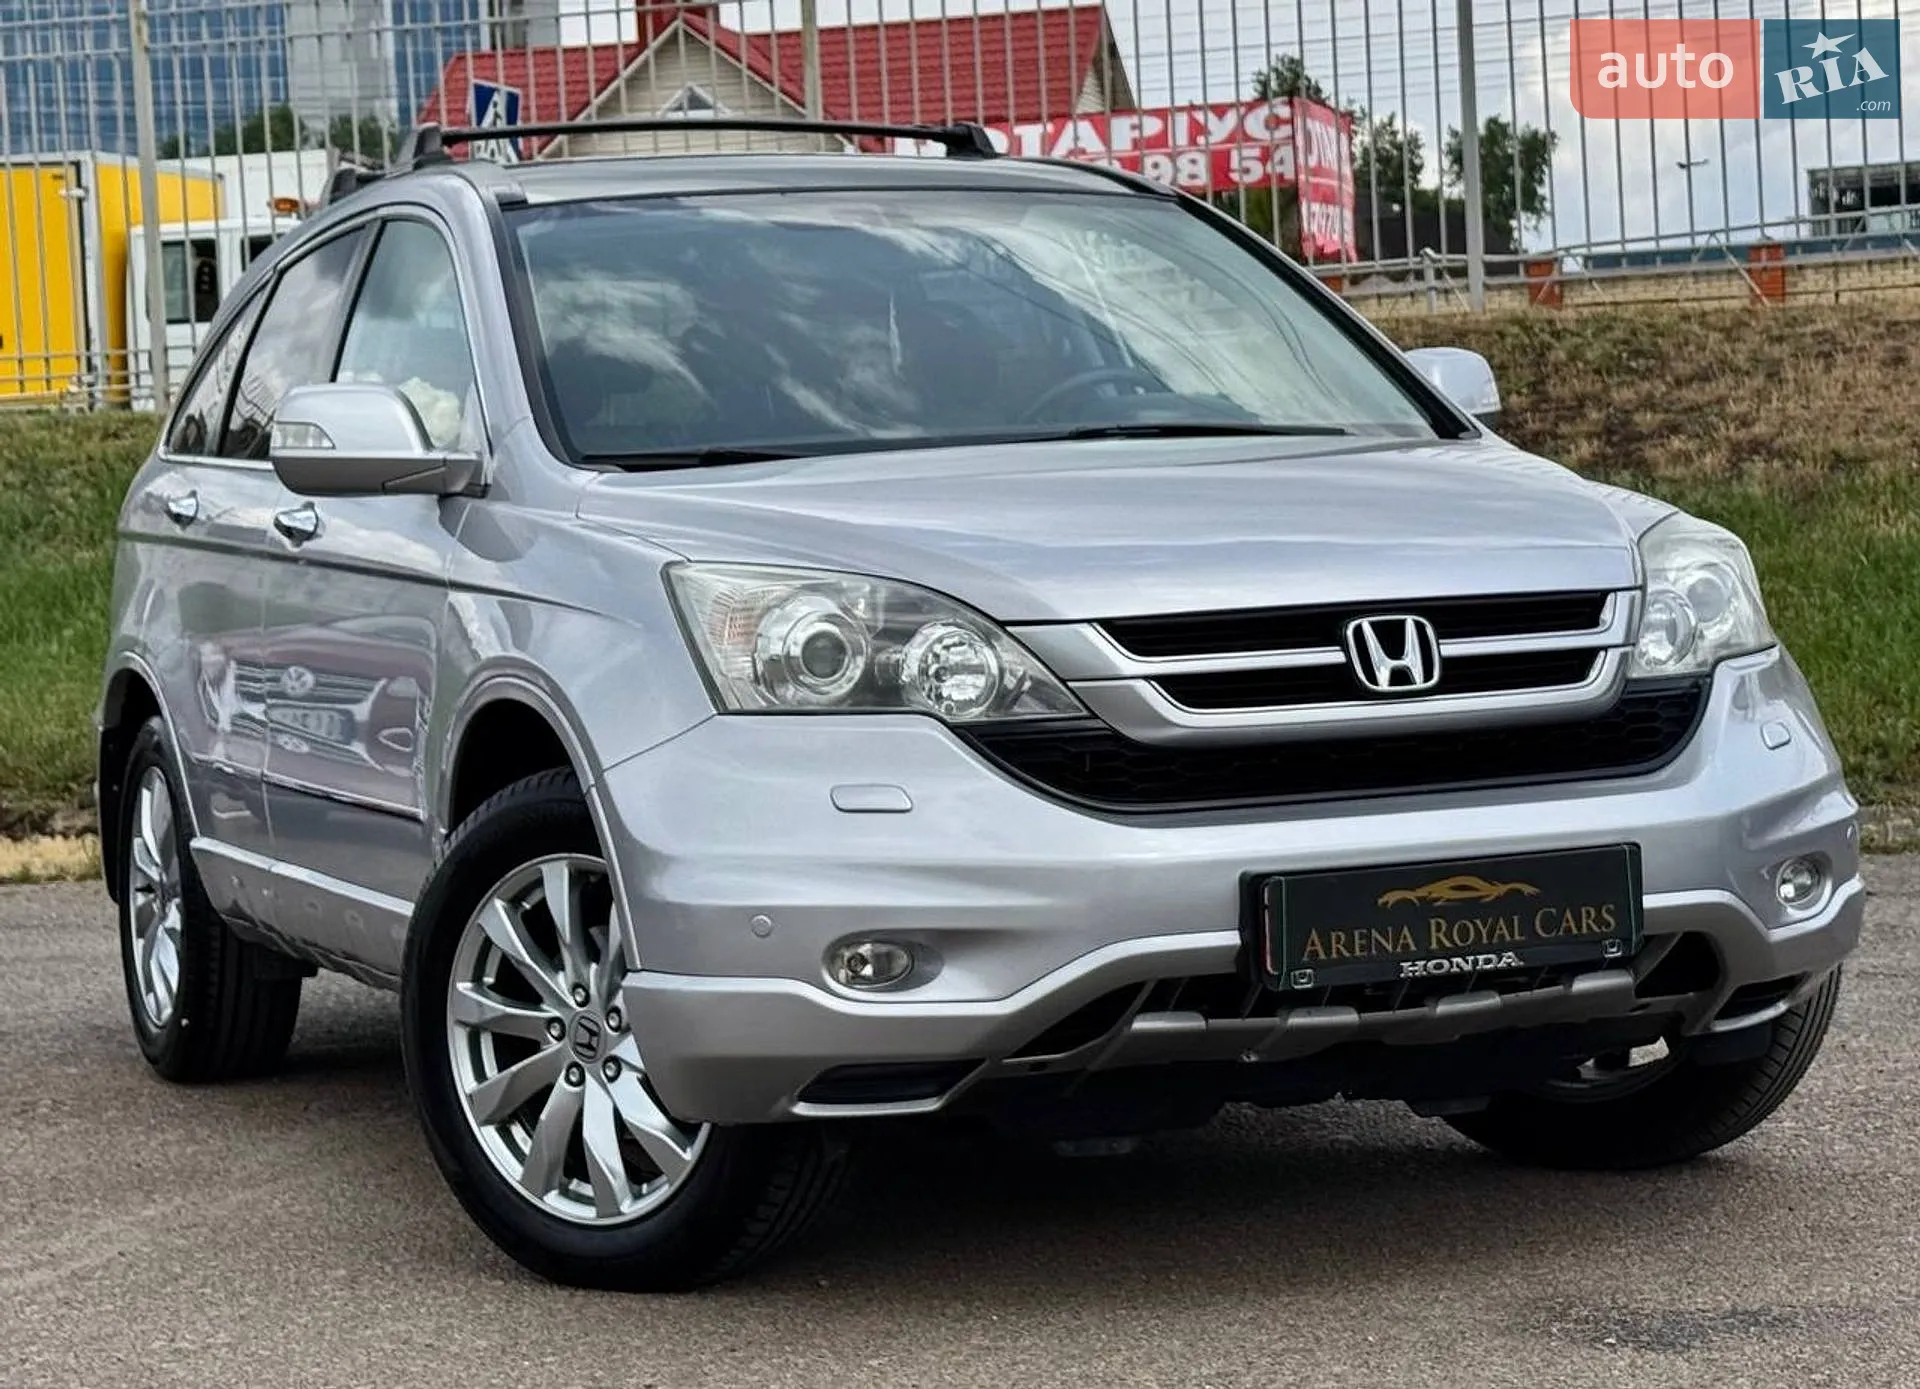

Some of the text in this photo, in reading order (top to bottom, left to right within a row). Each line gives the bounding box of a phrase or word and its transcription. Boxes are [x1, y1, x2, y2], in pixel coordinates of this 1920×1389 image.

[894, 97, 1293, 158] ТАРІУС
[1143, 152, 1207, 187] 98
[1228, 145, 1296, 184] 54
[1303, 904, 1616, 961] ARENA ROYAL CARS
[1399, 951, 1524, 978] HONDA
